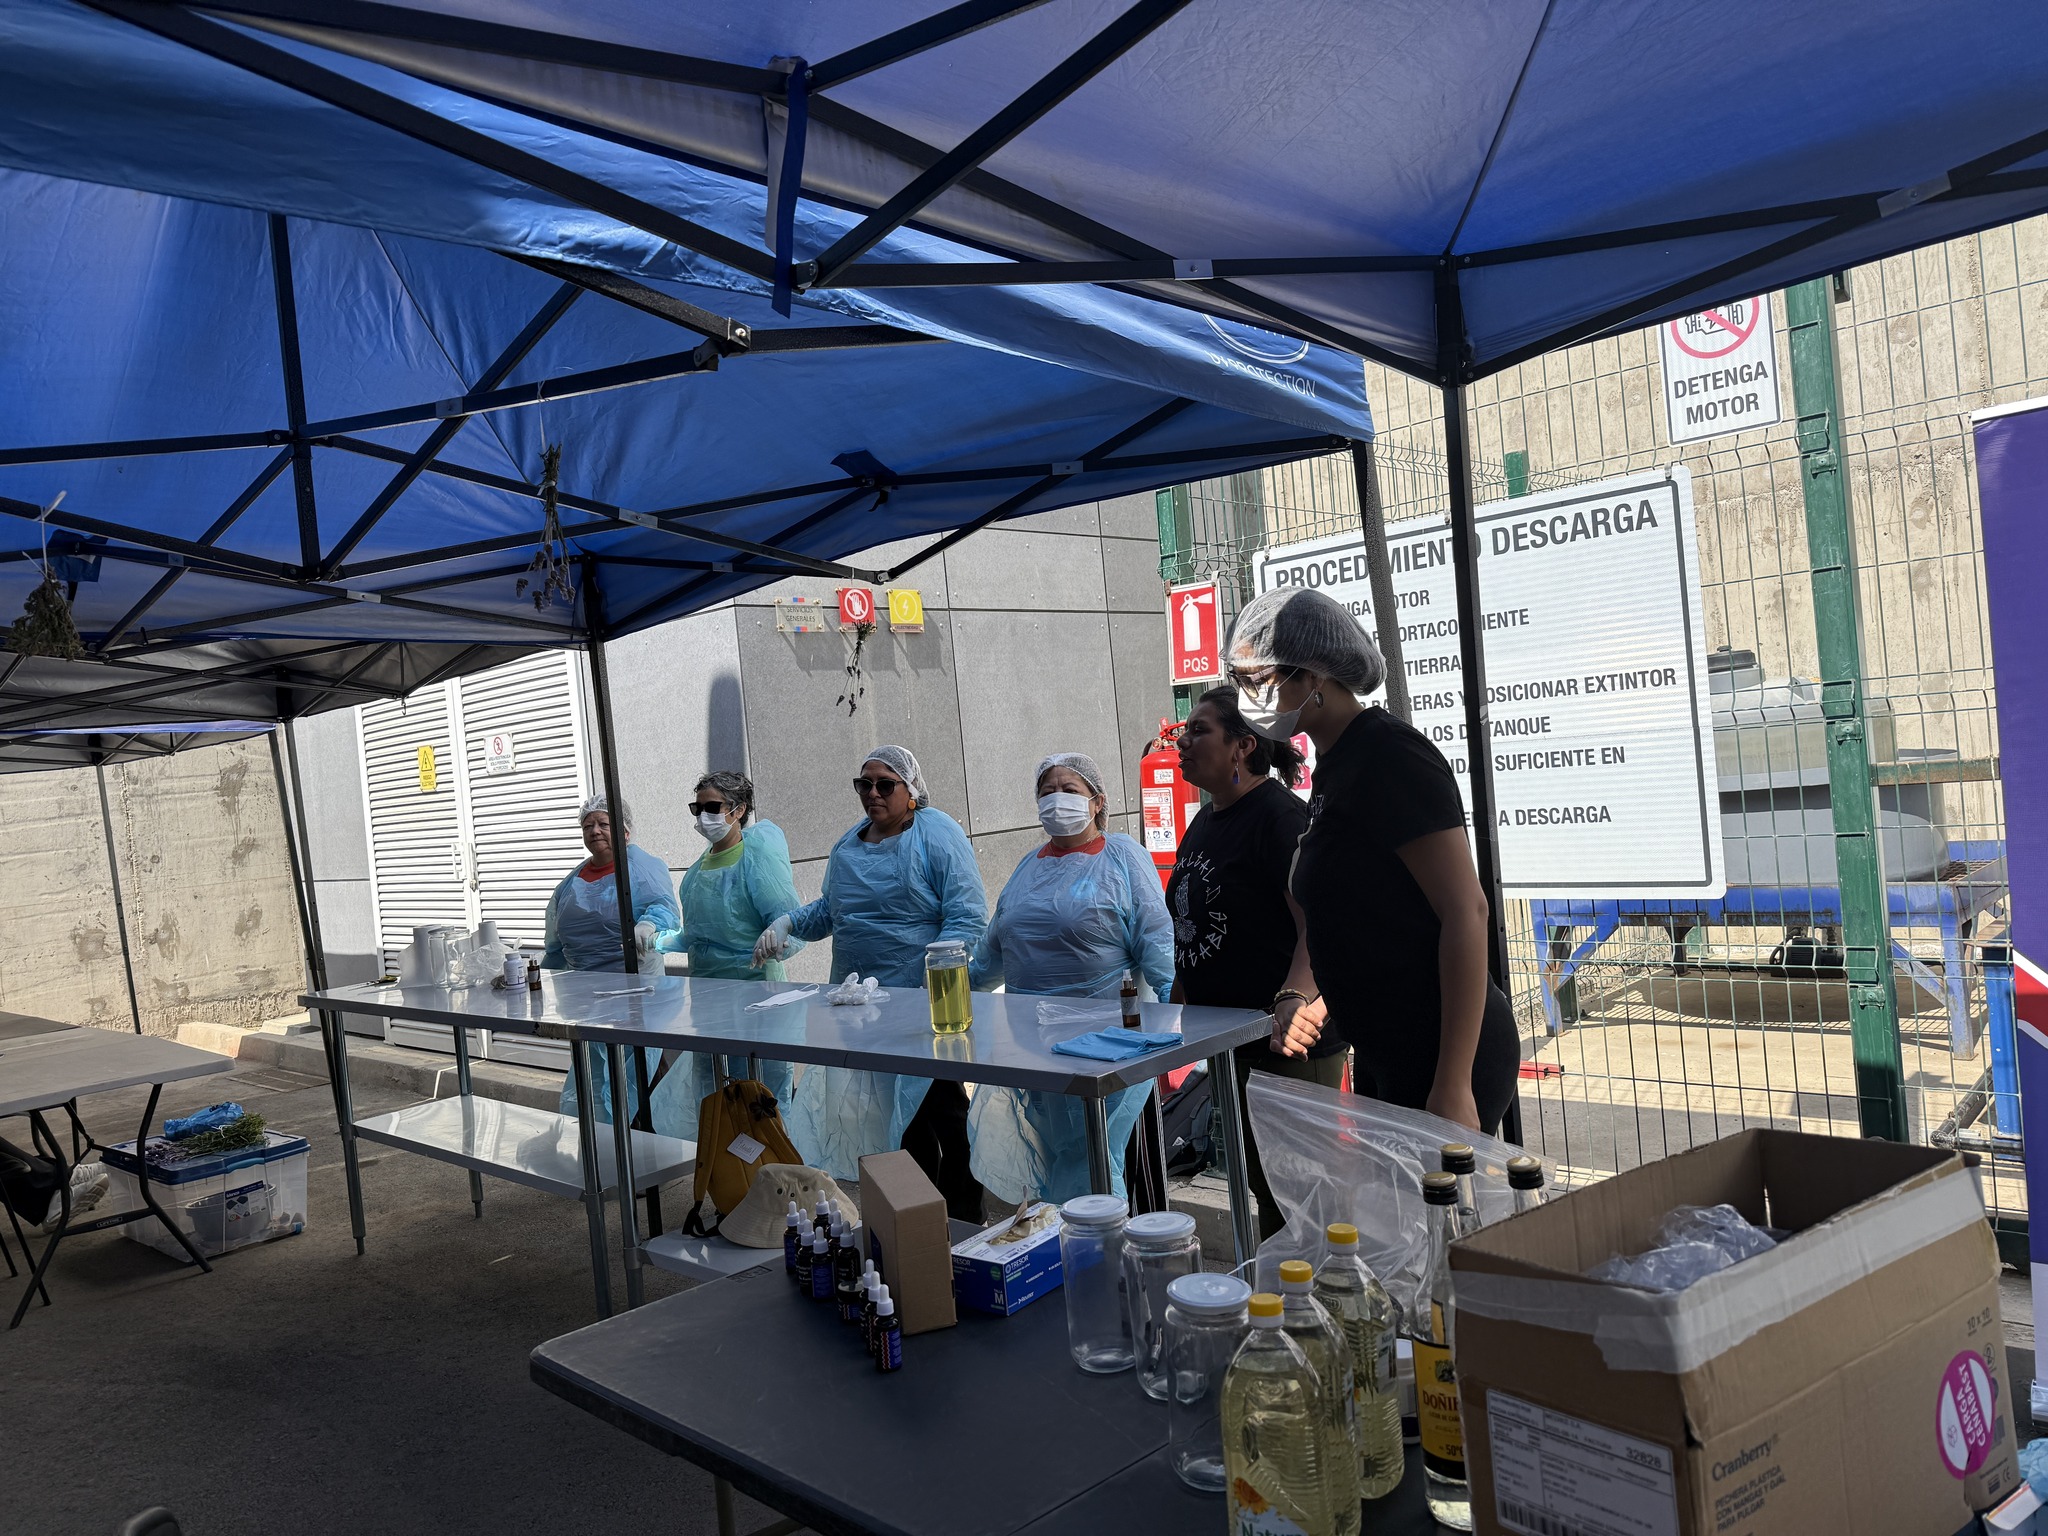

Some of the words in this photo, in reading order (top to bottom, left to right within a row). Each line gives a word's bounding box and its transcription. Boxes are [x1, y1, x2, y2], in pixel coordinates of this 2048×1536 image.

[1227, 358, 1316, 398] PROTECTION
[1673, 361, 1769, 399] DETENGA
[1686, 393, 1760, 425] MOTOR
[1491, 499, 1659, 556] DESCARGA
[1183, 656, 1209, 673] PQS
[1404, 654, 1462, 676] TIERRA
[1486, 678, 1579, 704] OSICIONAR
[1584, 667, 1677, 694] EXTINTOR
[1489, 716, 1552, 738] ANQUE
[1494, 748, 1596, 772] SUFICIENTE
[1601, 746, 1626, 765] EN
[1515, 805, 1612, 826] DESCARGA
[953, 1256, 971, 1266] RESOR
[994, 1292, 1004, 1305] M
[1967, 1316, 1977, 1330] 10
[1981, 1307, 1991, 1322] 10
[1958, 1363, 1986, 1447] CENABAST
[1956, 1391, 1976, 1446] CARGA
[1625, 1446, 1662, 1468] 32828
[1715, 1483, 1748, 1509] PECHERA
[1716, 1507, 1733, 1522] CON
[1733, 1486, 1764, 1511] MANGAS
[1717, 1515, 1737, 1533] PARA
[1737, 1497, 1765, 1522] PULGAR
